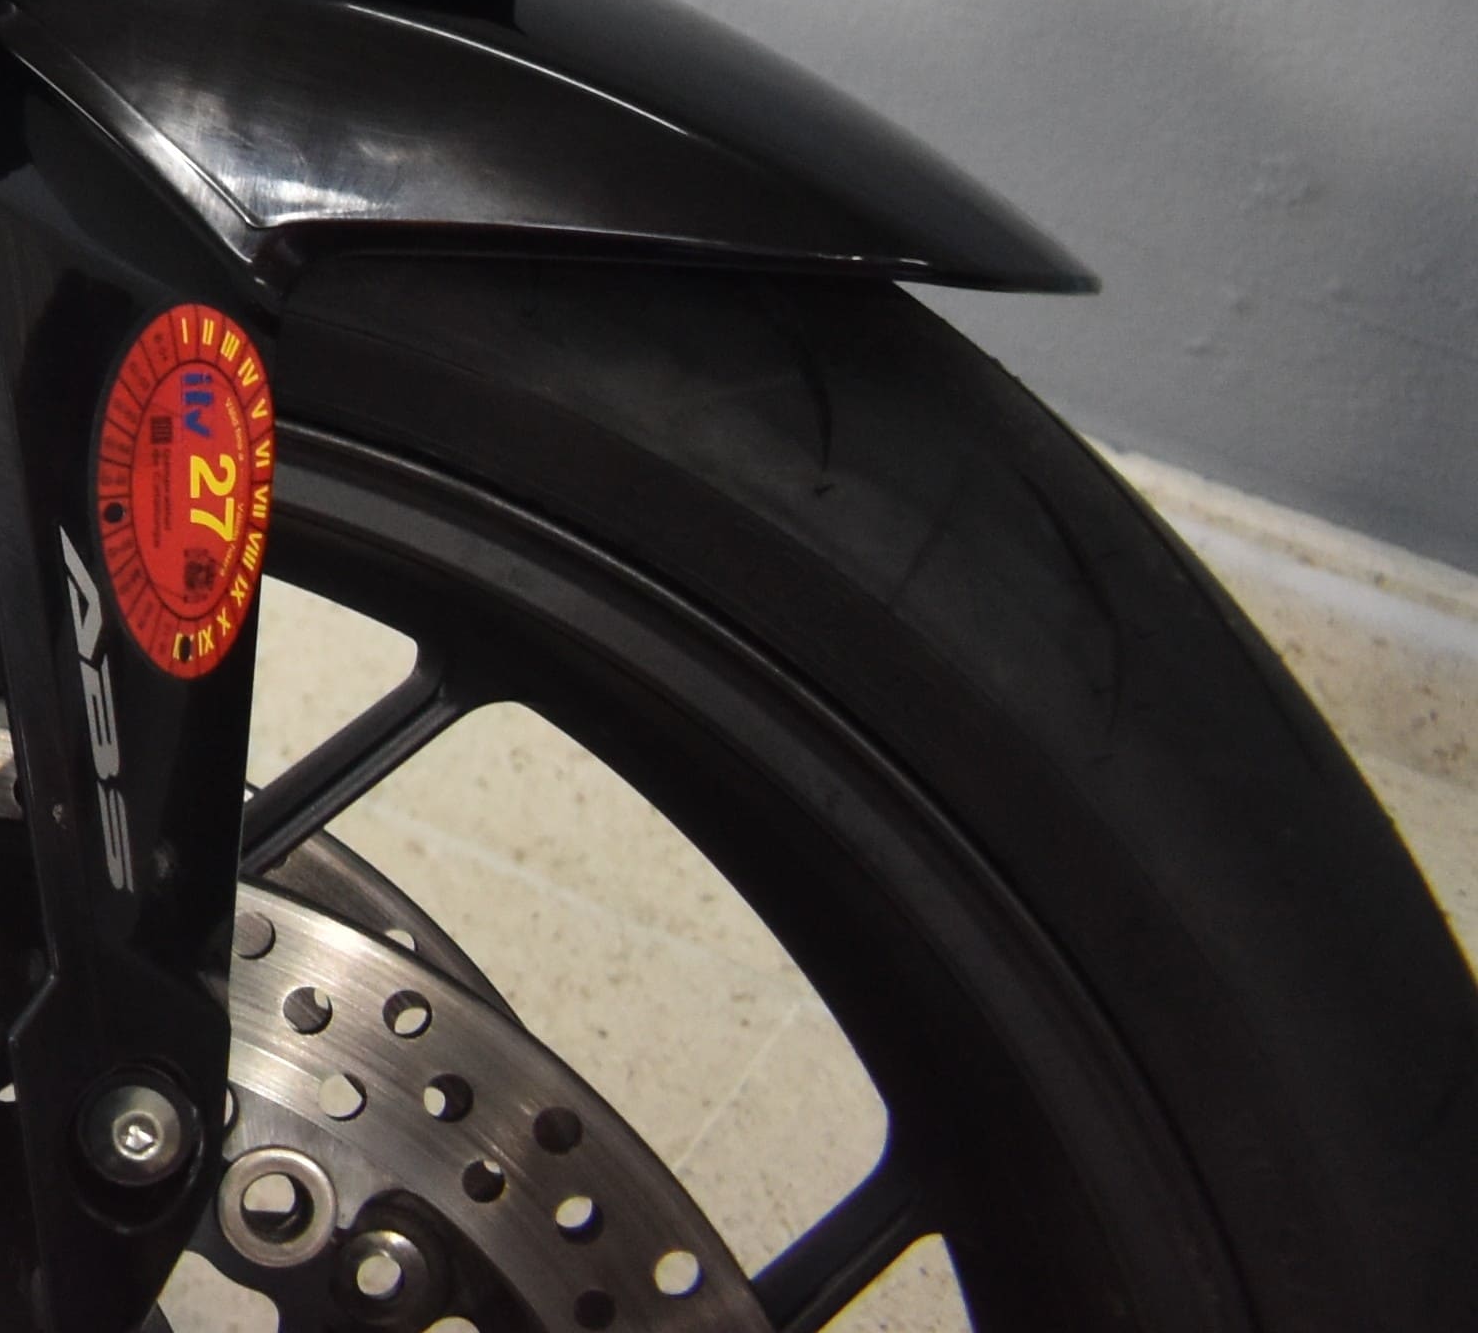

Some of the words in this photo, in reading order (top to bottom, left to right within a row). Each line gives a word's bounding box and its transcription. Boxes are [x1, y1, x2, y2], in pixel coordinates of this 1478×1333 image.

[220, 330, 241, 362] III
[237, 356, 259, 387] IV
[251, 397, 269, 419] V
[254, 439, 271, 468] VI
[190, 453, 237, 542] 27
[252, 484, 269, 519] VII
[241, 532, 263, 571] VIII
[230, 573, 249, 608] IX
[216, 606, 231, 637] X
[60, 525, 134, 894] ABS
